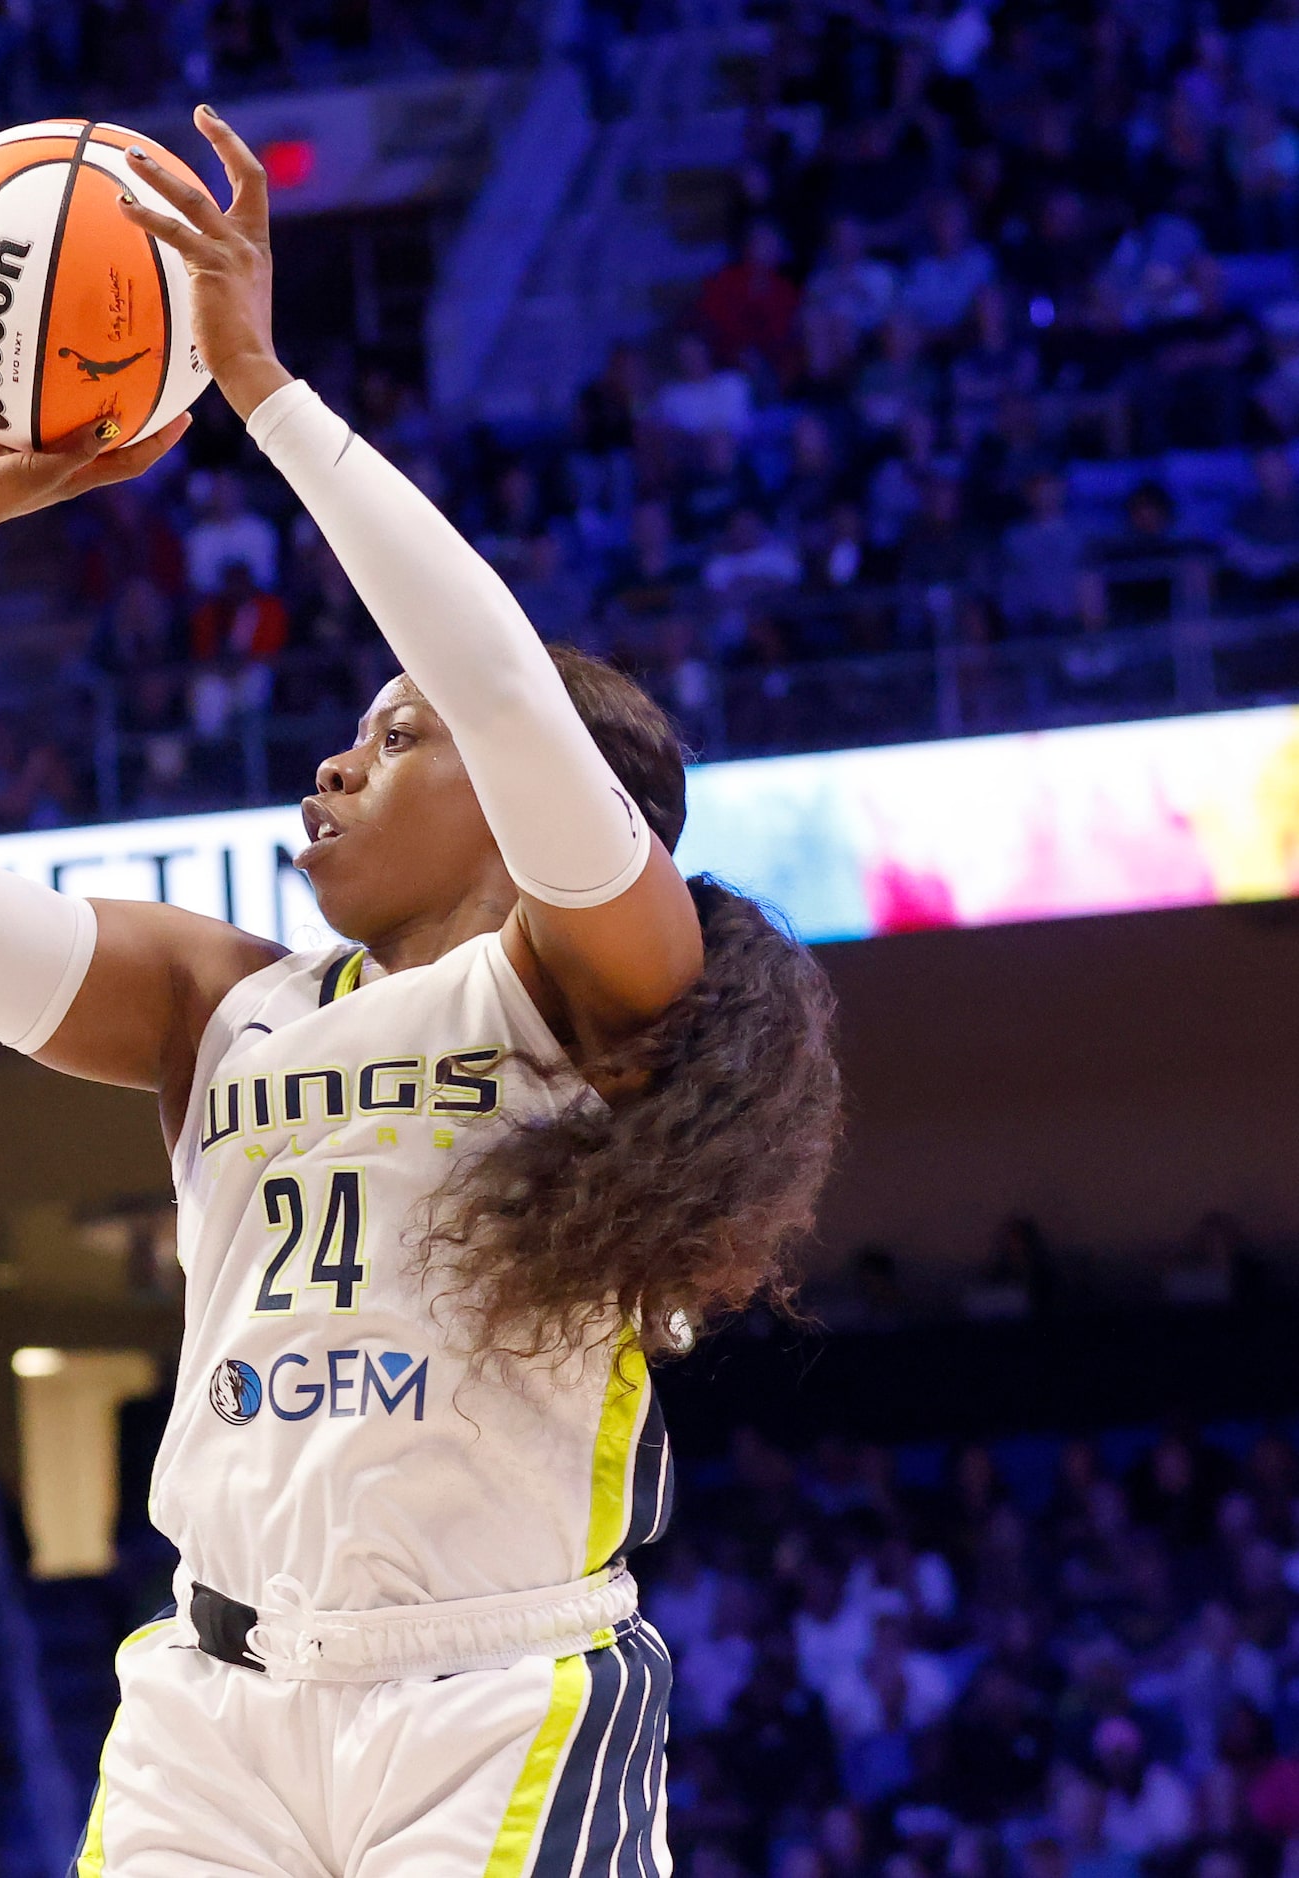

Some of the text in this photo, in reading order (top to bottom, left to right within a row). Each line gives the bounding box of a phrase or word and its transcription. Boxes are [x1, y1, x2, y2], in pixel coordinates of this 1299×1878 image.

[12, 330, 23, 384] EVO NXT
[201, 1044, 505, 1156] WINGS
[213, 1126, 455, 1179] ALLAS
[250, 1166, 370, 1318] 24
[268, 1350, 429, 1421] GEM
